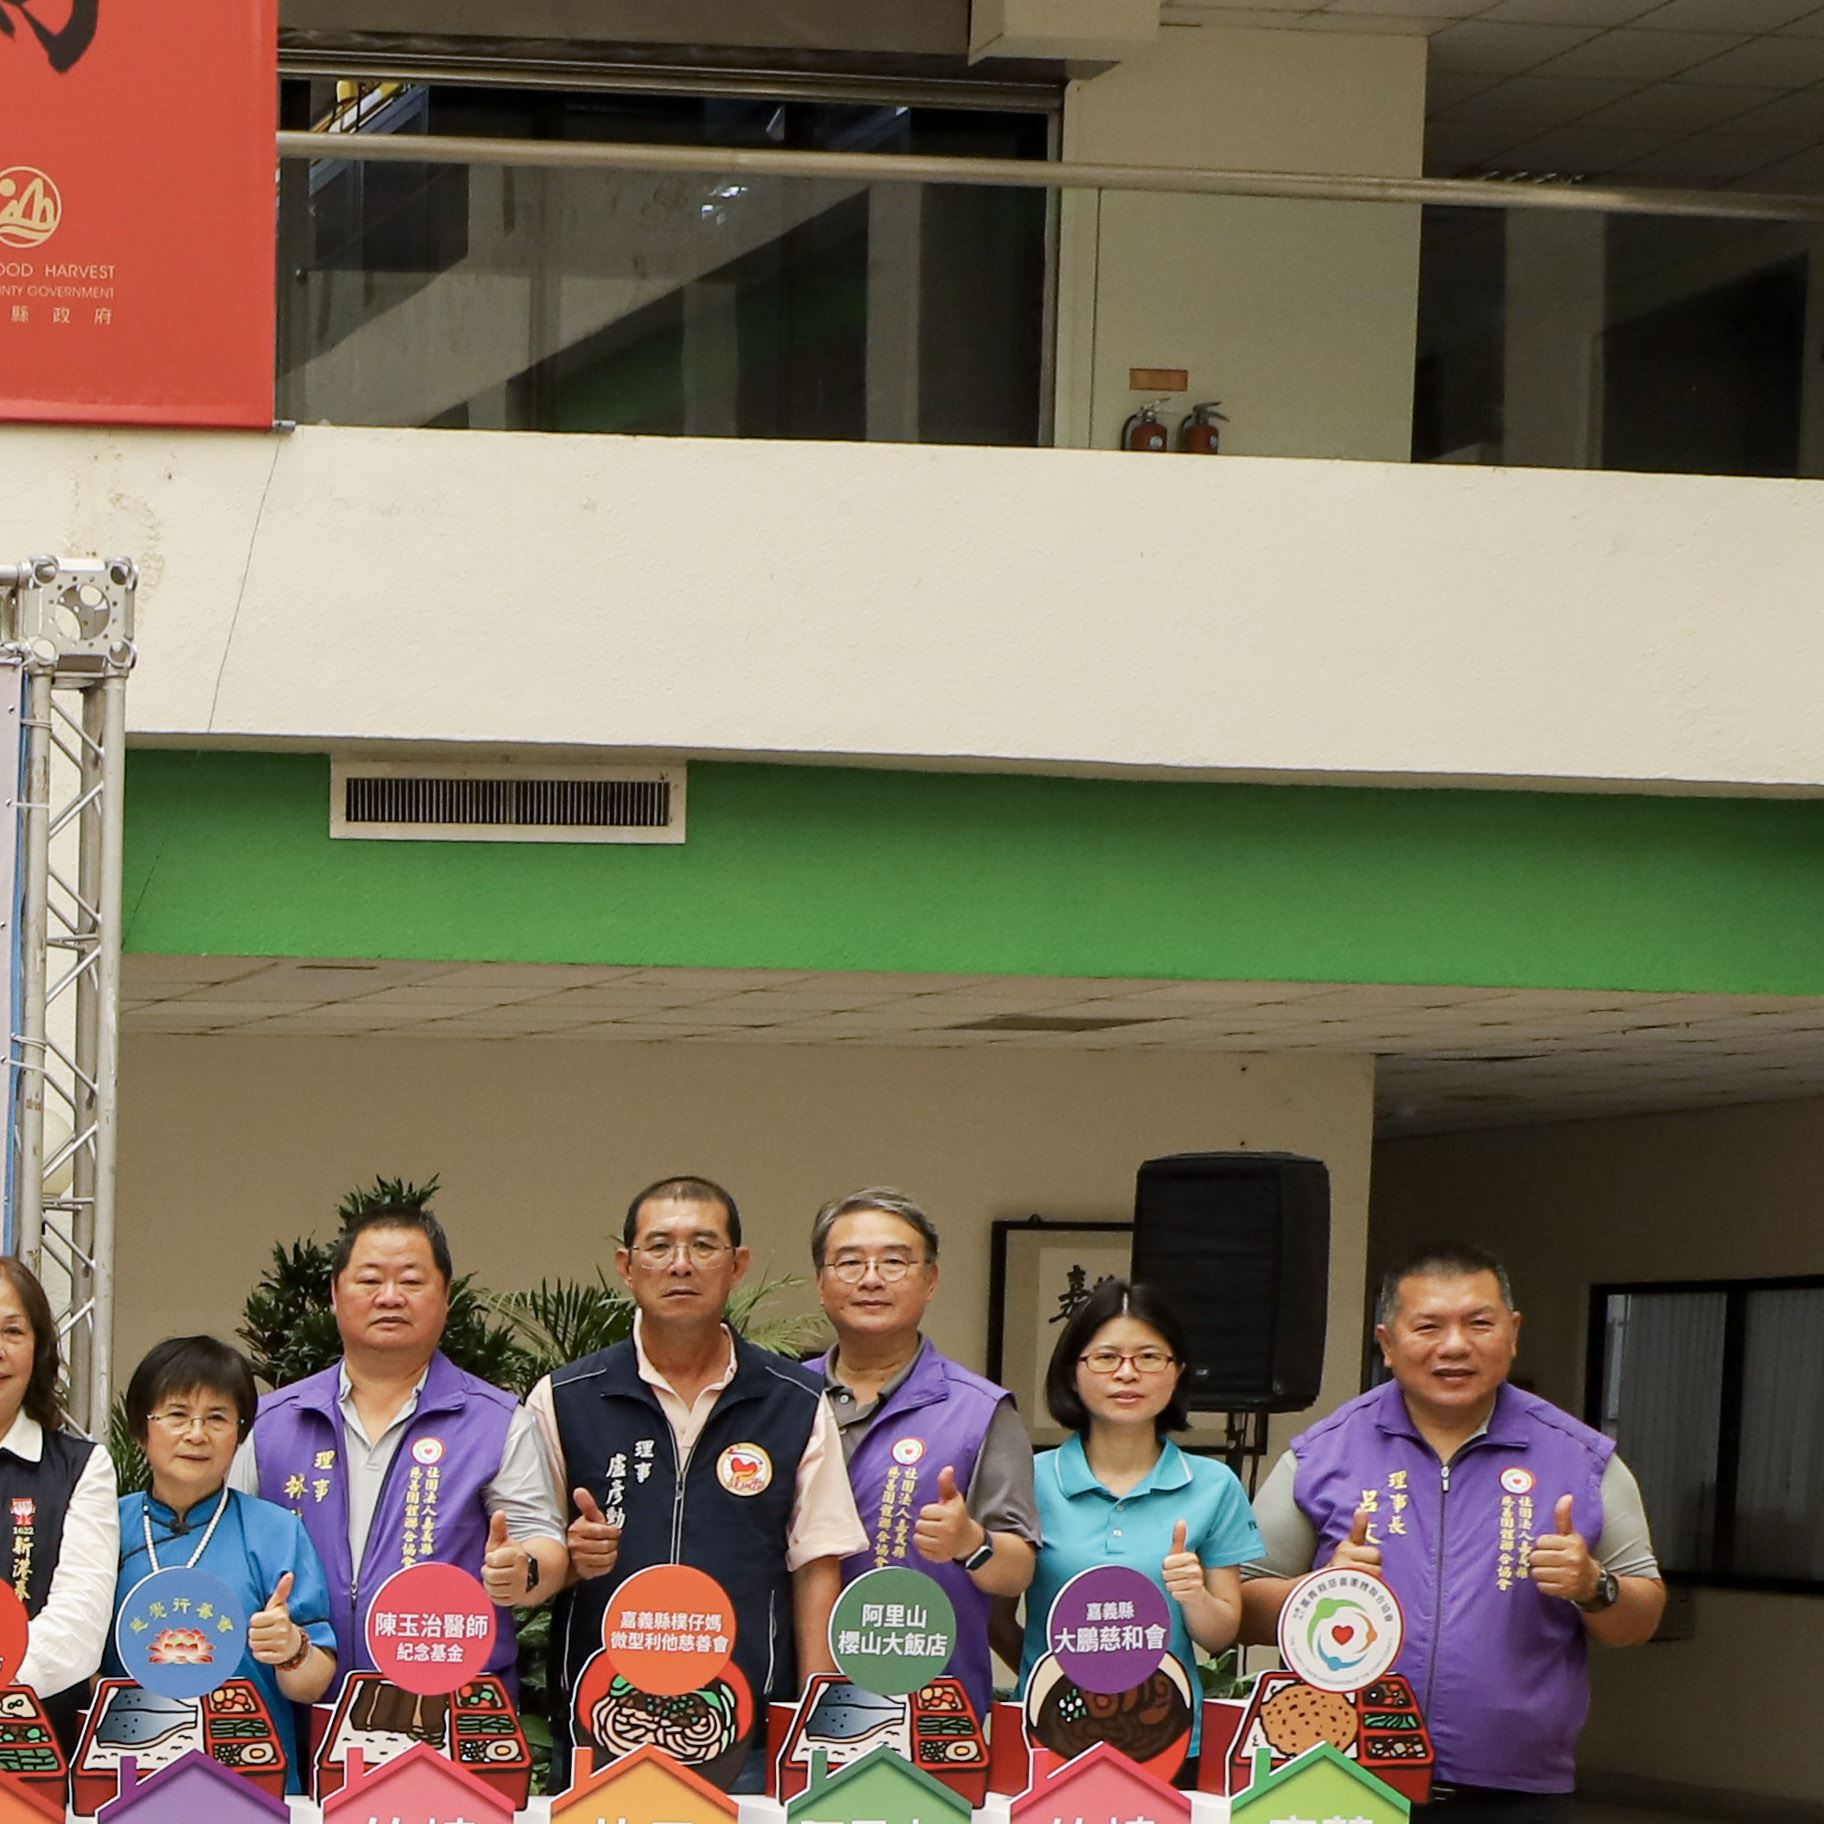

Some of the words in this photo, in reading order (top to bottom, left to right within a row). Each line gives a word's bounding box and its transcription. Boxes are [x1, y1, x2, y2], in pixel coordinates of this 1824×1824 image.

[44, 263, 116, 279] HARVEST
[634, 1439, 655, 1484] 理事
[1387, 1470, 1408, 1536] 理事長
[620, 1610, 722, 1633] 嘉義縣樸仔媽
[861, 1604, 927, 1628] 阿里山
[1086, 1601, 1135, 1621] 嘉義縣
[374, 1612, 488, 1641] 陳玉治醫師
[1053, 1624, 1167, 1653] 大鵬慈和會
[395, 1643, 465, 1664] 紀念基金
[610, 1631, 729, 1655] 微型利他慈善會
[837, 1629, 948, 1657] 櫻山大飯店
